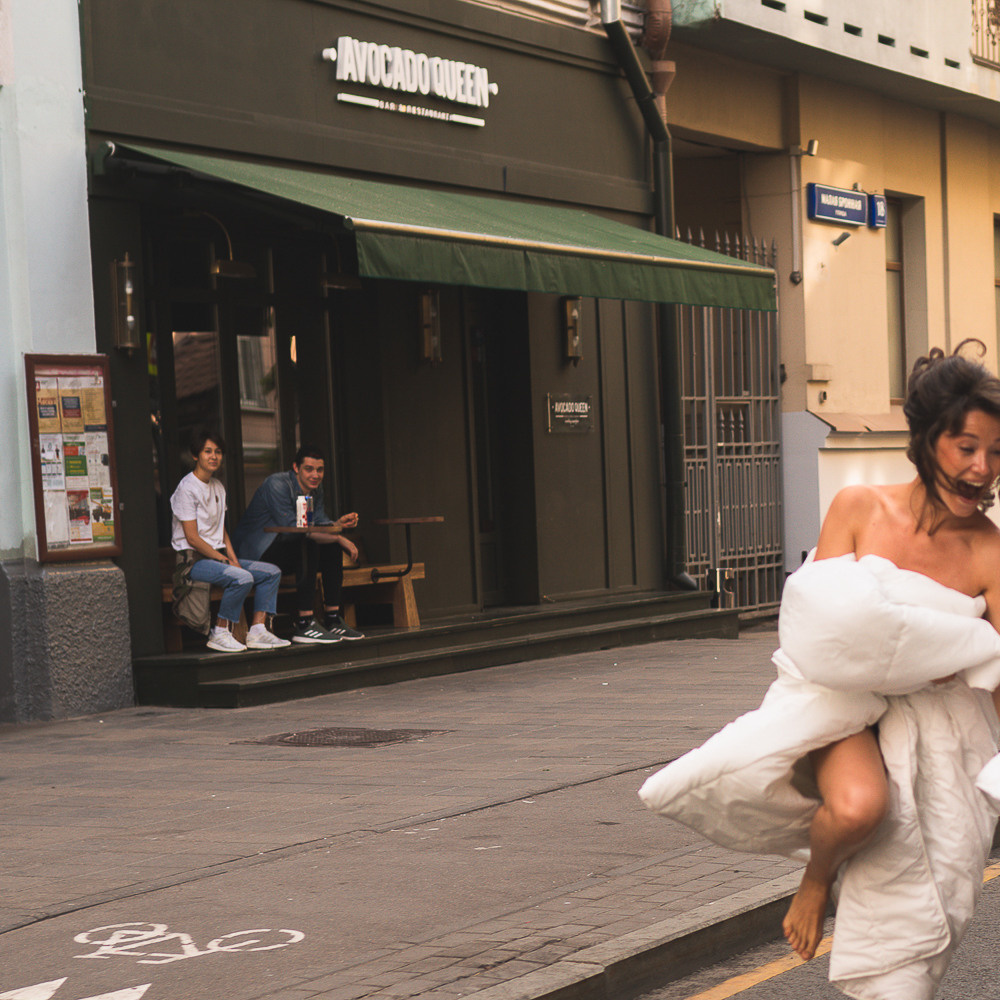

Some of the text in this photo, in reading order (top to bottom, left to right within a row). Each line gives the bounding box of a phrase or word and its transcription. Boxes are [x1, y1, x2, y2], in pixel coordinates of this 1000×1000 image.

[336, 36, 489, 108] AVOCADO QUEEN
[379, 100, 396, 111] BAR
[555, 402, 588, 413] AVOCADO QUEEN
